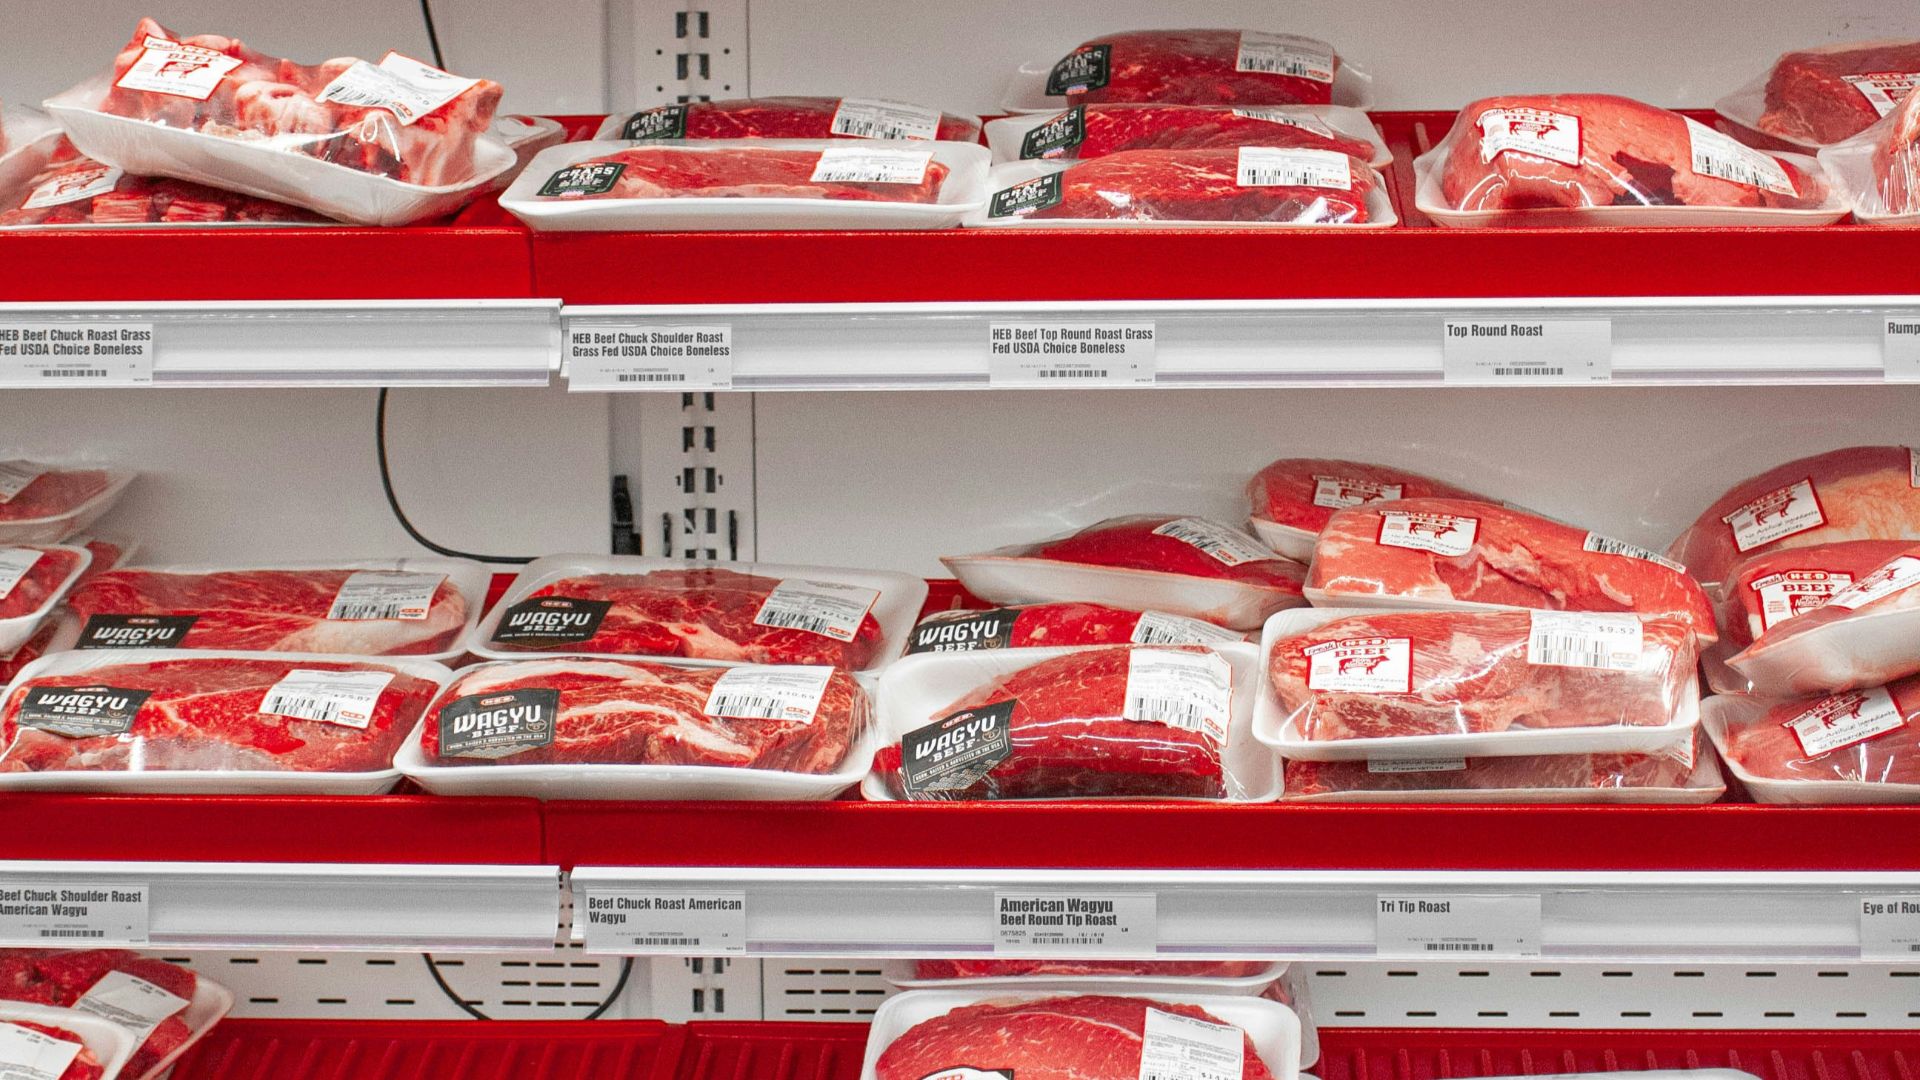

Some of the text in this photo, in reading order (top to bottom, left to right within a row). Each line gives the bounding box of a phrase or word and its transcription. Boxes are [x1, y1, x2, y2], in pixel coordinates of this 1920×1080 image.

[0, 329, 151, 341] HEB Beef Chuck Roast Grass
[993, 328, 1153, 341] HEB Beef Top Round Roast Grass
[1447, 324, 1543, 338] Top Round Roast
[1888, 322, 1920, 335] Rump
[573, 332, 723, 343] HEB Beef Chuck Shoulder Roast
[0, 344, 143, 355] Fed USDA Choice Boneless
[573, 345, 729, 356] Grass Fed USDA Choice Boneless
[993, 342, 1125, 354] Fed USDA Choice Boneless
[1782, 584, 1835, 592] BEEF
[509, 612, 591, 626] WAGYU
[93, 627, 176, 640] WAGYU
[919, 620, 1000, 646] WAGYU
[934, 642, 977, 652] BEEF
[1335, 648, 1390, 658] BEEF
[38, 694, 128, 710] WAGYU
[52, 706, 100, 715] BEEF
[454, 705, 541, 734] WAGYU
[472, 725, 519, 738] BEEF
[916, 715, 996, 760] WAGYU
[933, 738, 976, 762] BEEF
[24, 890, 57, 901] Chuck
[61, 890, 108, 902] Shoulder
[112, 890, 142, 902] Roast
[589, 897, 742, 910] Beef Chuck Roast American
[1000, 898, 1113, 914] American Wagyu
[1381, 901, 1450, 914] Tri Tip Roast
[1864, 902, 1883, 915] Eye
[1887, 902, 1898, 913] of
[0, 904, 87, 917] American Wagyu
[589, 911, 626, 924] Wagyu
[1000, 914, 1117, 927] Beef Round Tip Roast
